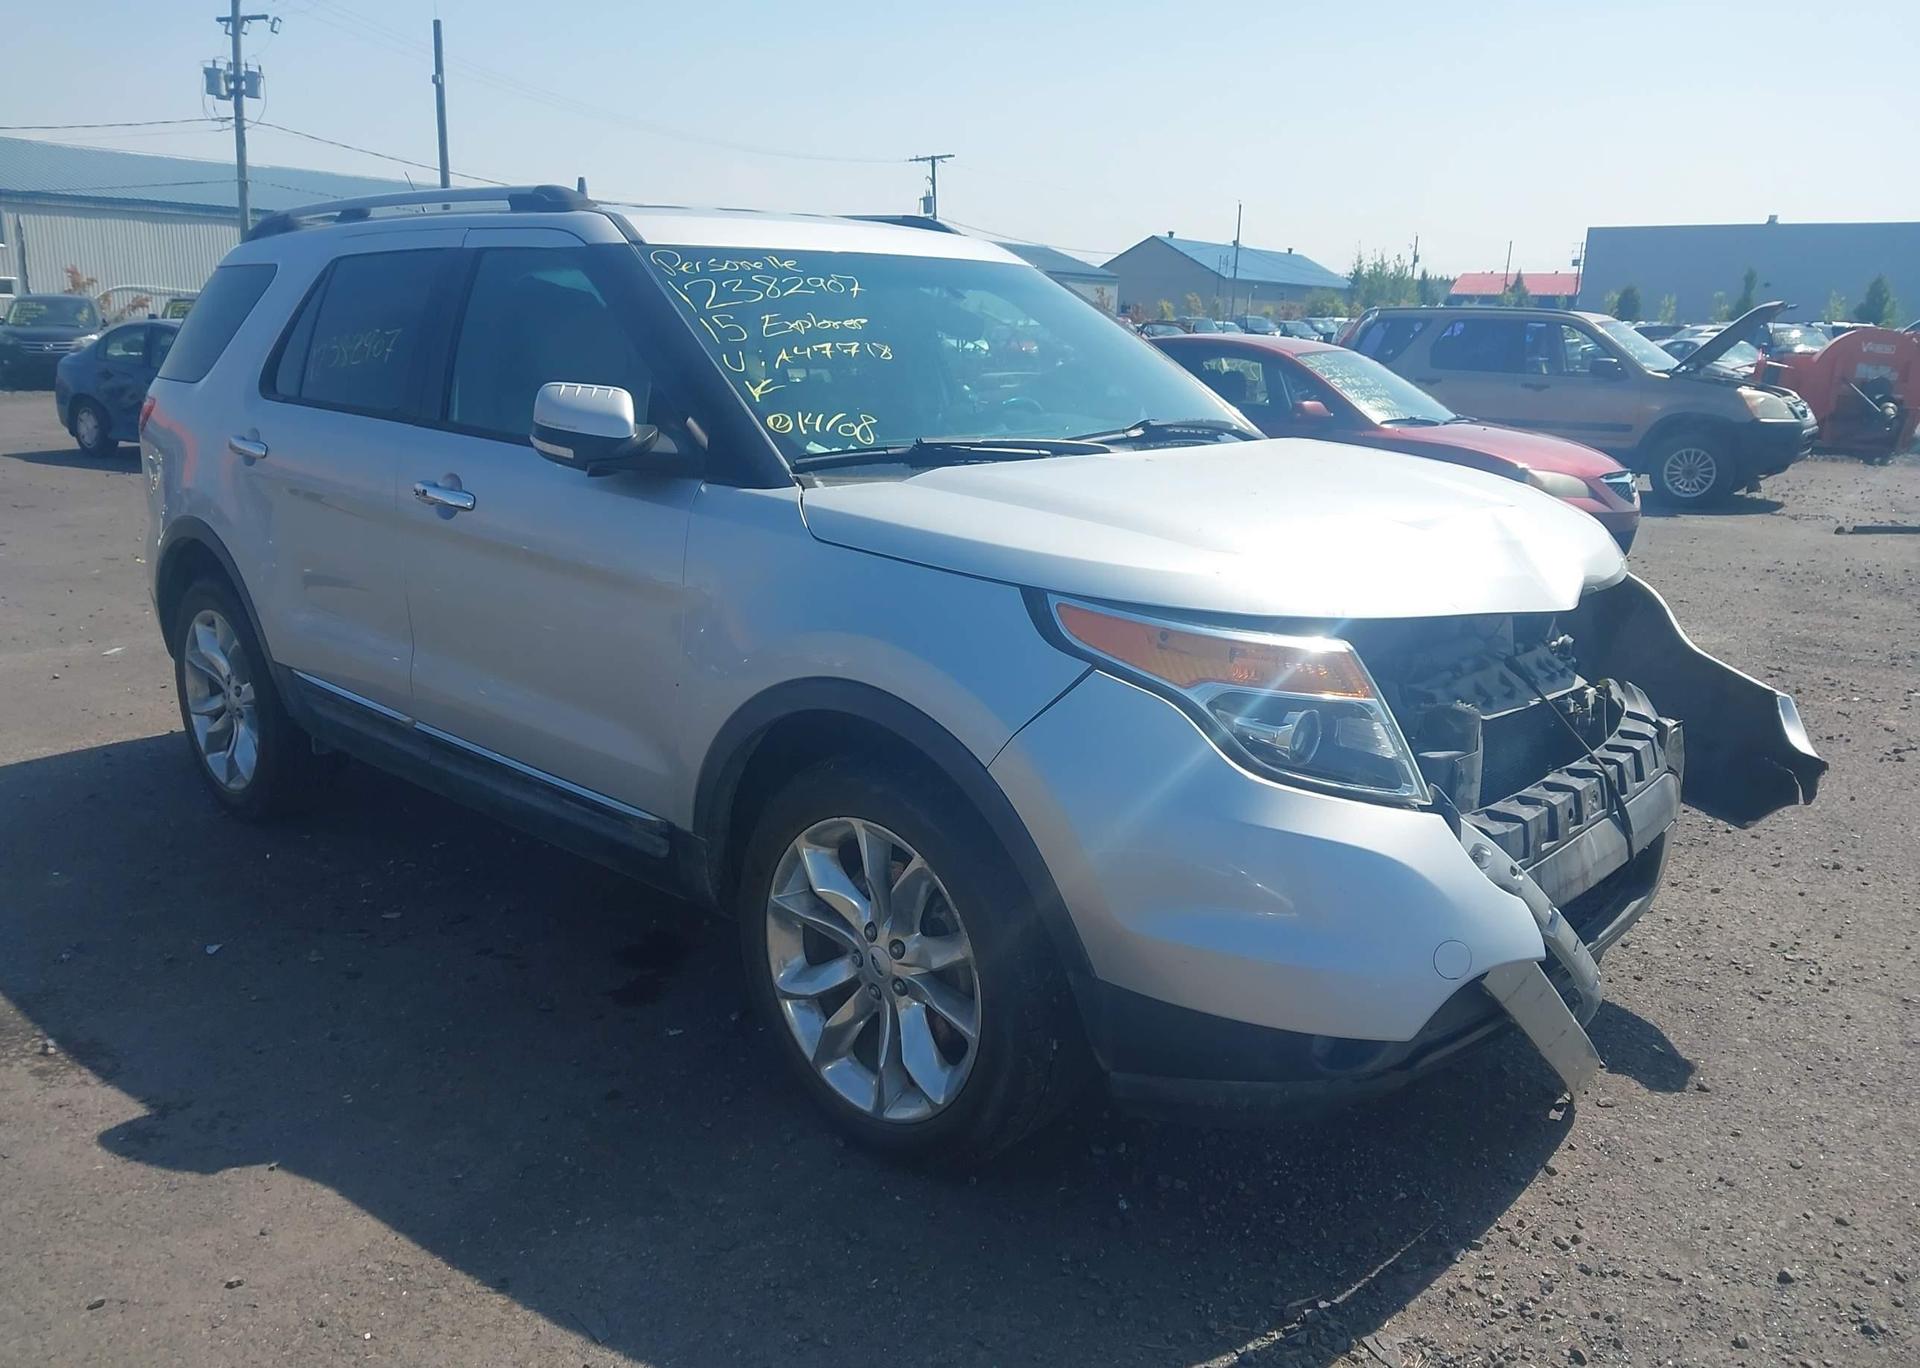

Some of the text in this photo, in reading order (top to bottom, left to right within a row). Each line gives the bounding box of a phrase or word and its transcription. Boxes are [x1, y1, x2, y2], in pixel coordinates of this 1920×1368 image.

[667, 273, 867, 313] 12382907
[699, 312, 868, 344] 15 Explorer
